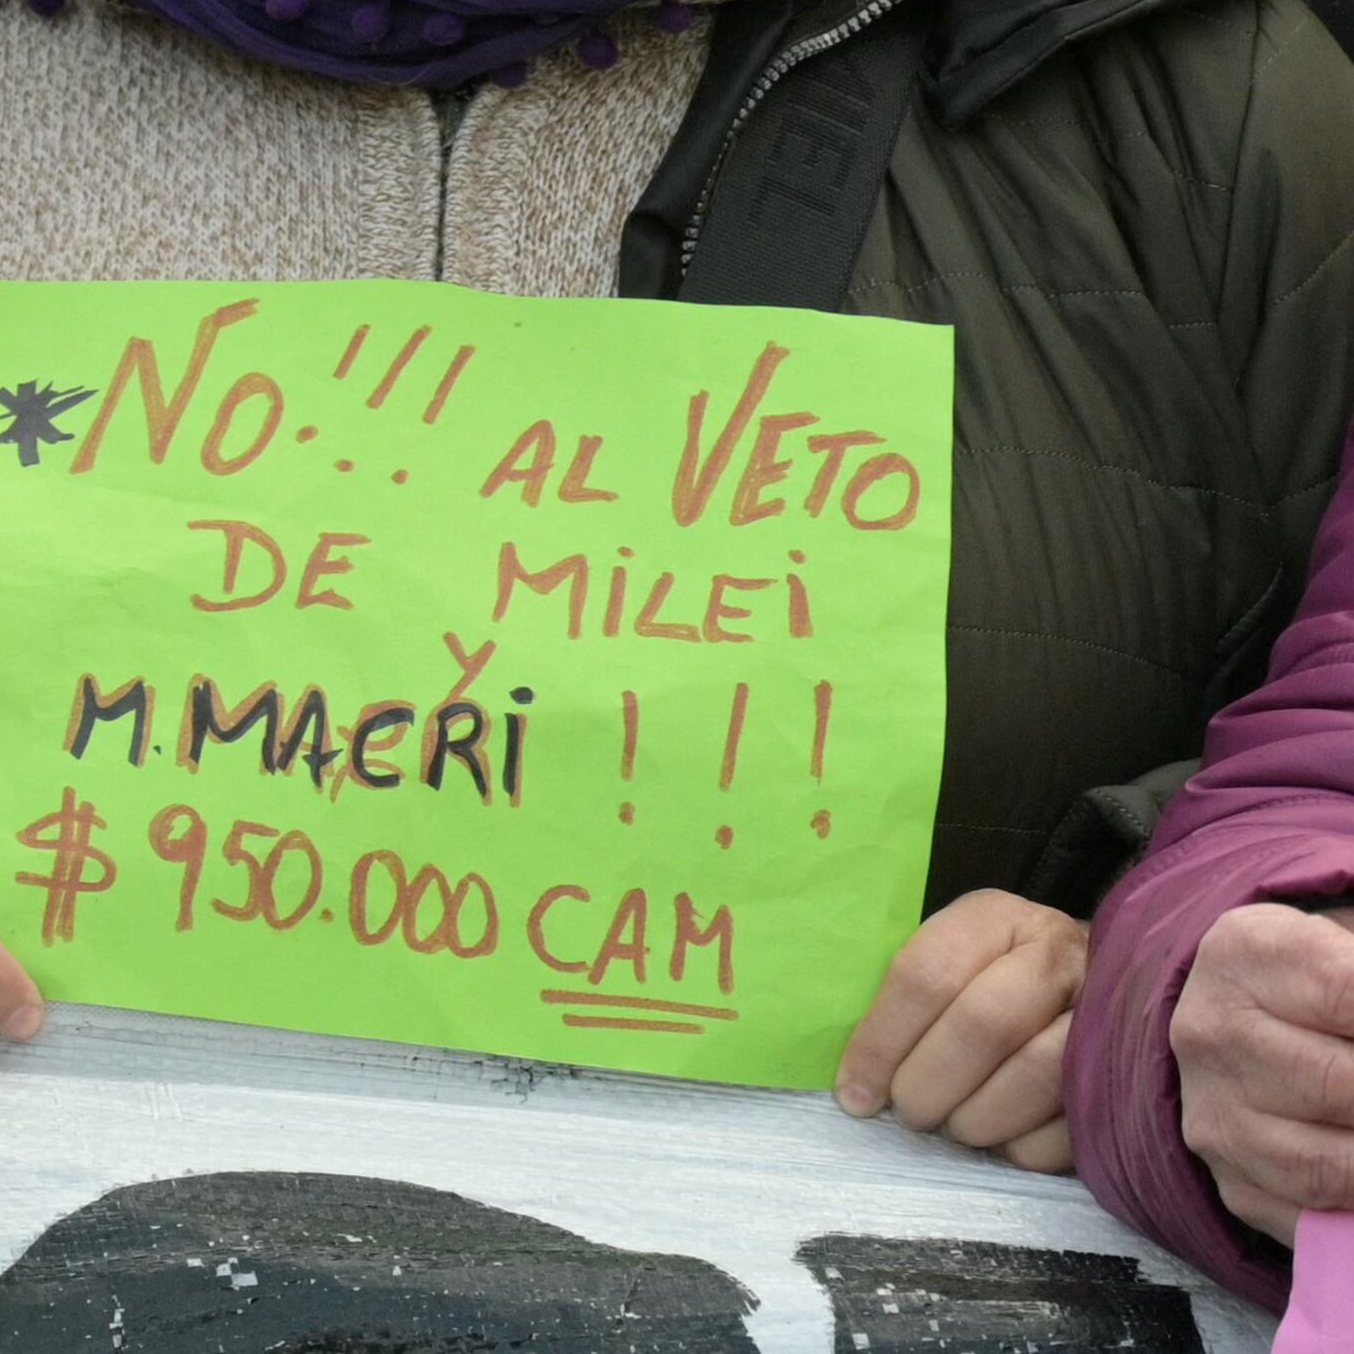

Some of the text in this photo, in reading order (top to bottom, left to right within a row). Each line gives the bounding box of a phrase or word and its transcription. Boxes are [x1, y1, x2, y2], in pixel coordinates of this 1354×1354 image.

[480, 418, 620, 508] AL
[671, 341, 923, 532] VETO
[188, 519, 372, 613] DE
[526, 884, 736, 995] CAM
